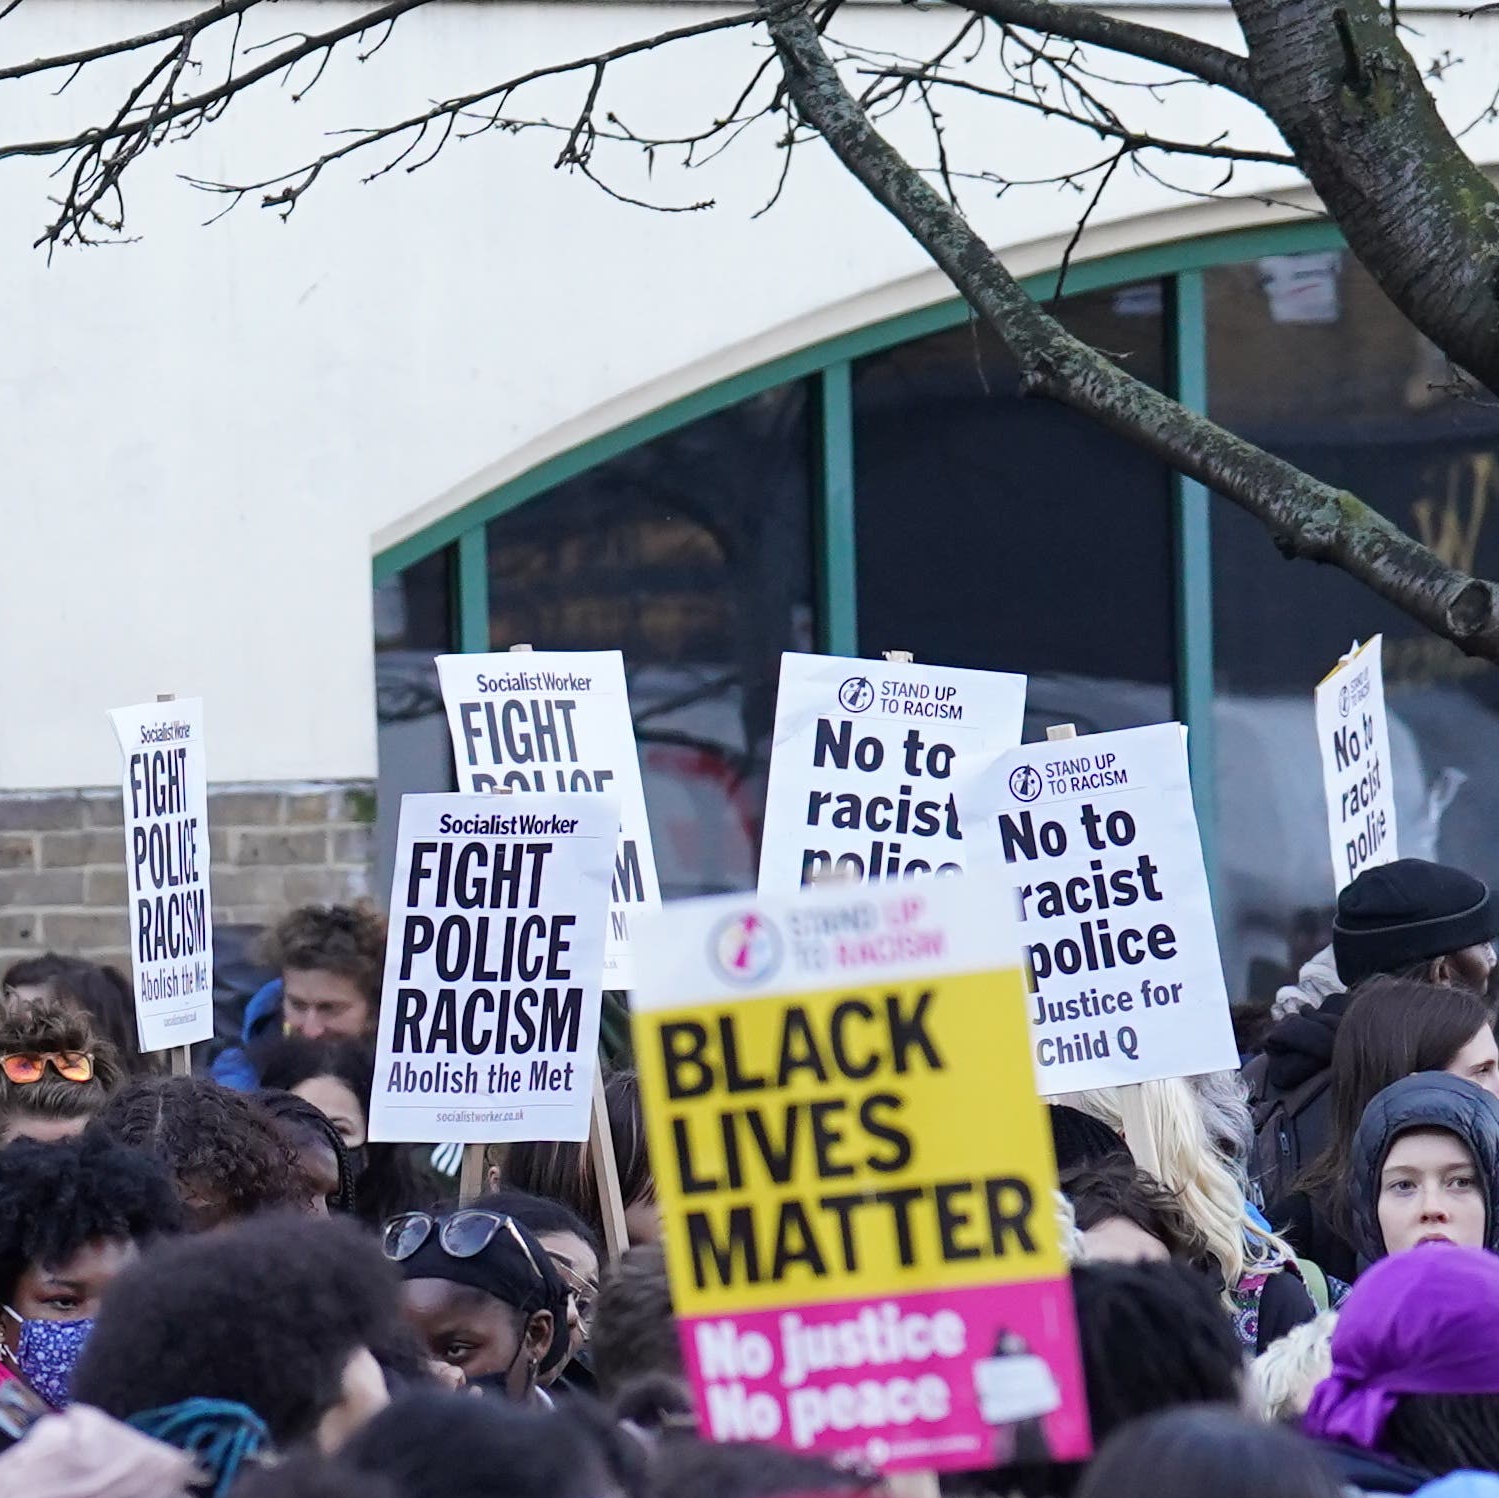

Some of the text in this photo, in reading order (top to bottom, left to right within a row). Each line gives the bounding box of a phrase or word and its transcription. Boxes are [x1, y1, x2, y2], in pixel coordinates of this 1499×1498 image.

[880, 698, 963, 720] TO RACISM
[881, 680, 957, 701] STAND UP
[459, 698, 579, 766] FIGHT
[813, 718, 956, 779] No to
[1045, 753, 1116, 778] STAND UP
[1333, 712, 1373, 773] No to
[130, 748, 187, 819] FIGHT
[807, 784, 963, 841] racist
[1048, 769, 1128, 796] TO RACISM
[1342, 750, 1381, 823] racist
[133, 818, 199, 891] POLICE
[998, 803, 1137, 864] No to
[407, 841, 553, 910] FIGHT
[1016, 854, 1163, 923] racist
[139, 889, 206, 963] RACISM
[399, 914, 576, 983] POLICE
[1021, 919, 1179, 994] police
[141, 961, 208, 1002] Abolish the Met
[1033, 979, 1183, 1026] Justice for
[391, 987, 583, 1055] RACISM
[659, 988, 945, 1101] BLACK
[1037, 1025, 1139, 1067] Child Q
[387, 1060, 574, 1094] Abolish the Met
[672, 1093, 914, 1194] LIVES
[686, 1177, 1037, 1290] MATTER
[694, 1302, 968, 1387] No justice
[706, 1373, 952, 1449] No peace
